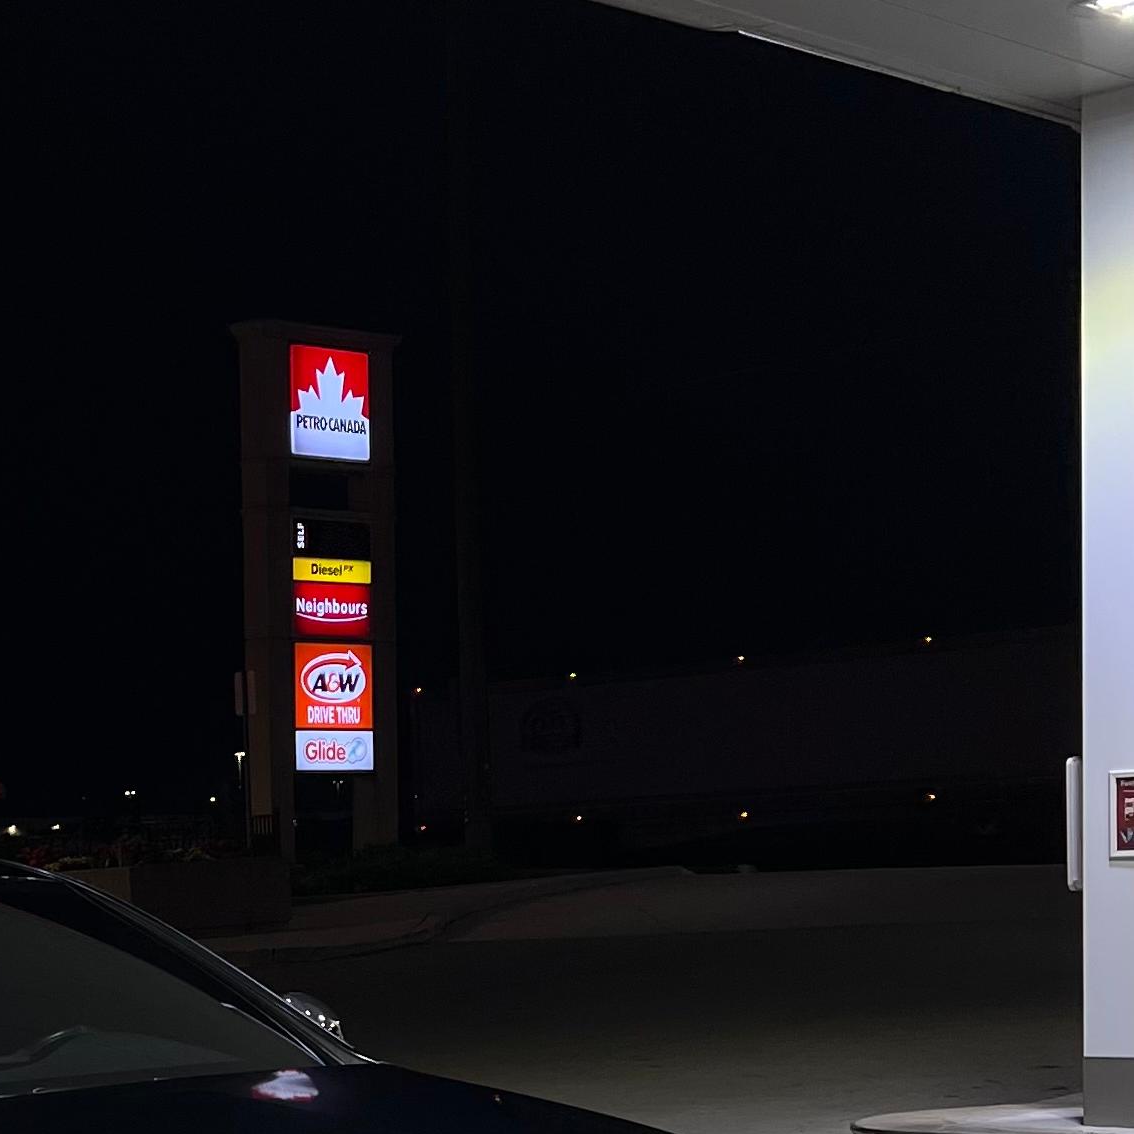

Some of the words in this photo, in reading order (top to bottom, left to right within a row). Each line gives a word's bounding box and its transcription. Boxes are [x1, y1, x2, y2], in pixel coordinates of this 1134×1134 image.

[311, 563, 343, 576] Diesel
[296, 597, 368, 617] Neighbours
[312, 672, 360, 693] A&W
[307, 705, 335, 725] DRIVE
[336, 706, 361, 725] THRU
[305, 740, 346, 761] Glide
